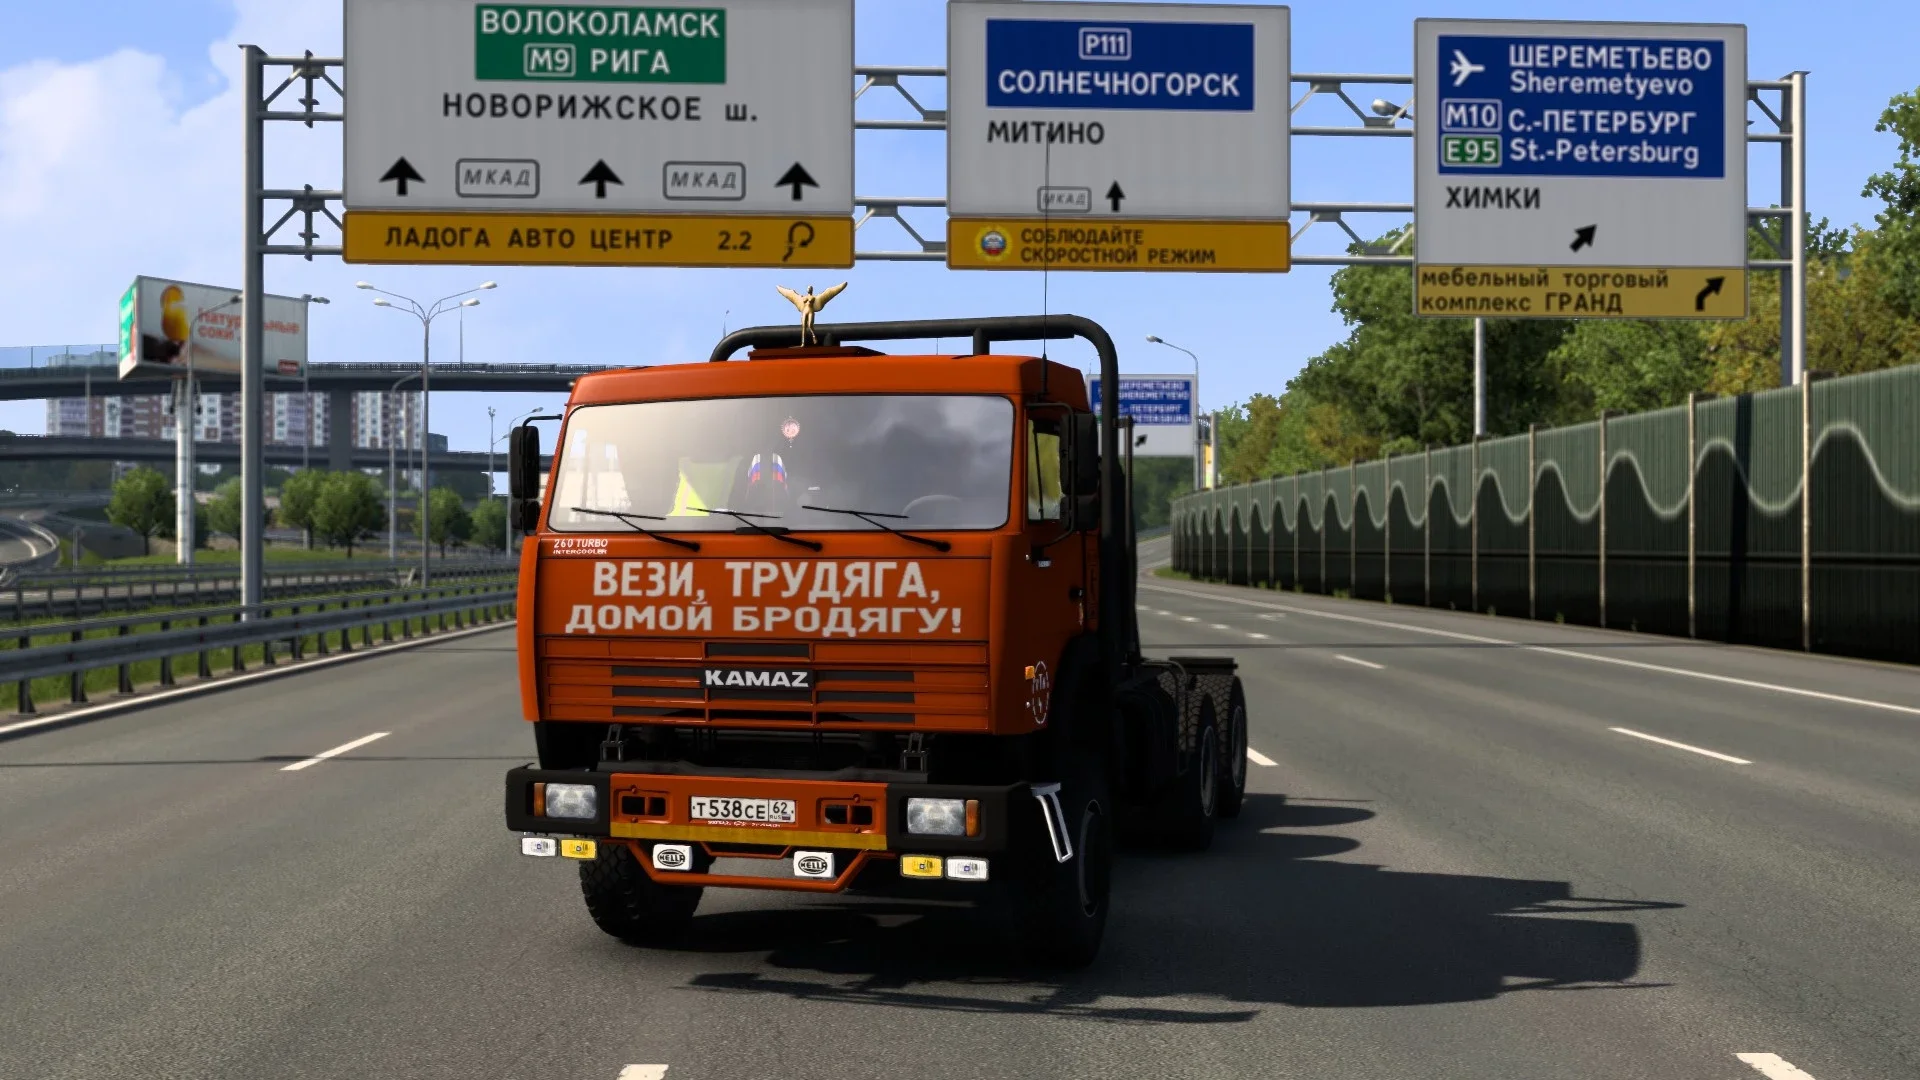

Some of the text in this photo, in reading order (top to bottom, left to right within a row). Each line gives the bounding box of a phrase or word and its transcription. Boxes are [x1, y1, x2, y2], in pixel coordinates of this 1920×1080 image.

[482, 10, 718, 37] ВОЛОКОЛАМСК
[592, 49, 669, 73] РИГА
[1510, 45, 1711, 70] ШЕРЕМЕТЬЕВО
[999, 70, 1239, 96] СОЛНЕЧНОГОРСК
[1511, 70, 1693, 100] Sheremetyevo
[444, 93, 757, 121] НОВОРИЖСКОЕ ш.
[988, 121, 1104, 145] МИТИНО
[1509, 109, 1696, 134] С.-ПЕТЕРБУРГ
[1444, 141, 1498, 162] E95
[1511, 138, 1698, 169] St.-Petersburg
[464, 169, 529, 186] МКАД
[671, 172, 736, 188] МКАД
[1043, 193, 1086, 205] МКАД
[1447, 187, 1540, 209] ХИМКИ
[386, 227, 752, 252] ЛАДОГА АВТО ЦЕНТР 2.2
[1021, 226, 1143, 245] СОБЛЮДАЙТЕ
[1021, 245, 1215, 264] СКОРОСТНОЙ РЕЖИМ
[1422, 268, 1668, 296] мебельный торговый
[1422, 293, 1623, 314] комплекс ГРАНД
[554, 539, 608, 548] 260 TURBO
[594, 562, 939, 604] ВЕЗИ, ТРУДЯГА,
[565, 602, 961, 637] ДОМОЙ БРОДЯГУ!
[705, 670, 808, 687] KAMAZ
[658, 854, 685, 863] HELLA
[800, 862, 827, 870] HELLA
